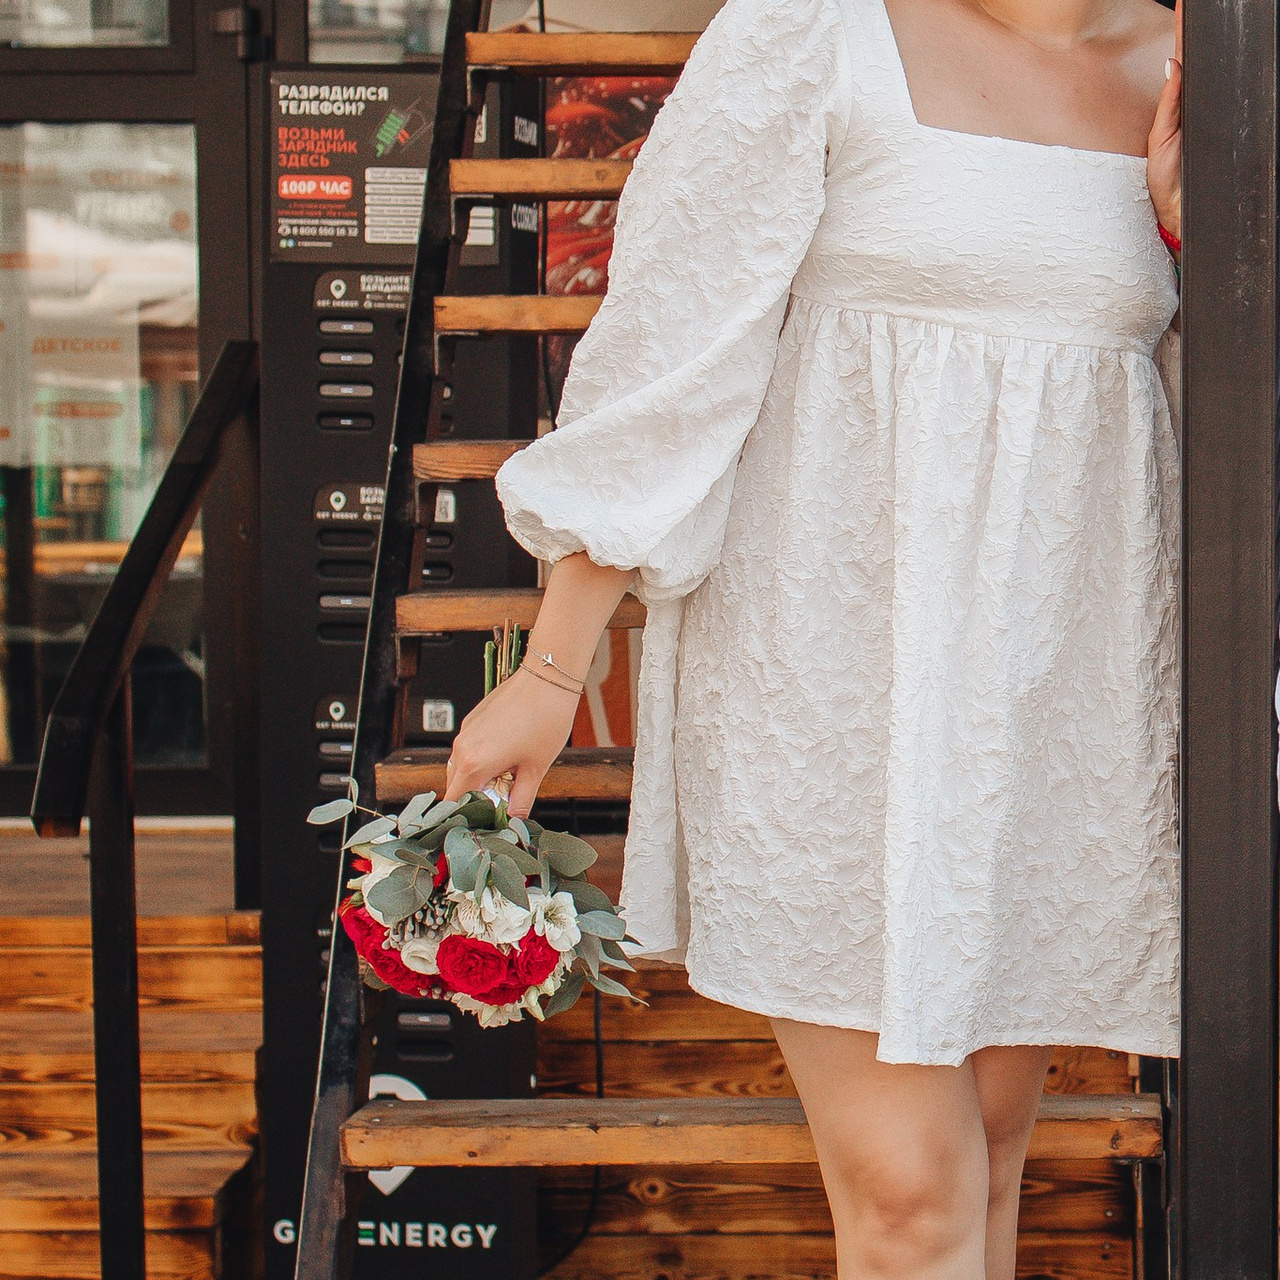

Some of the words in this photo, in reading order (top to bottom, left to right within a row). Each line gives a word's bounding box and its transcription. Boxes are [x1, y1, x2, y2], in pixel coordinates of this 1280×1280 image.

[278, 84, 389, 102] РАЗРЯДИЛСЯ
[279, 100, 366, 116] ТЕЛЕФОН?
[278, 127, 345, 142] ВОЗЬМИ
[278, 140, 358, 155] ЗАРЯДНИК
[278, 153, 330, 169] ЗДЕСЬ
[320, 180, 350, 195] ЧАС
[357, 1220, 498, 1249] ENERGY
